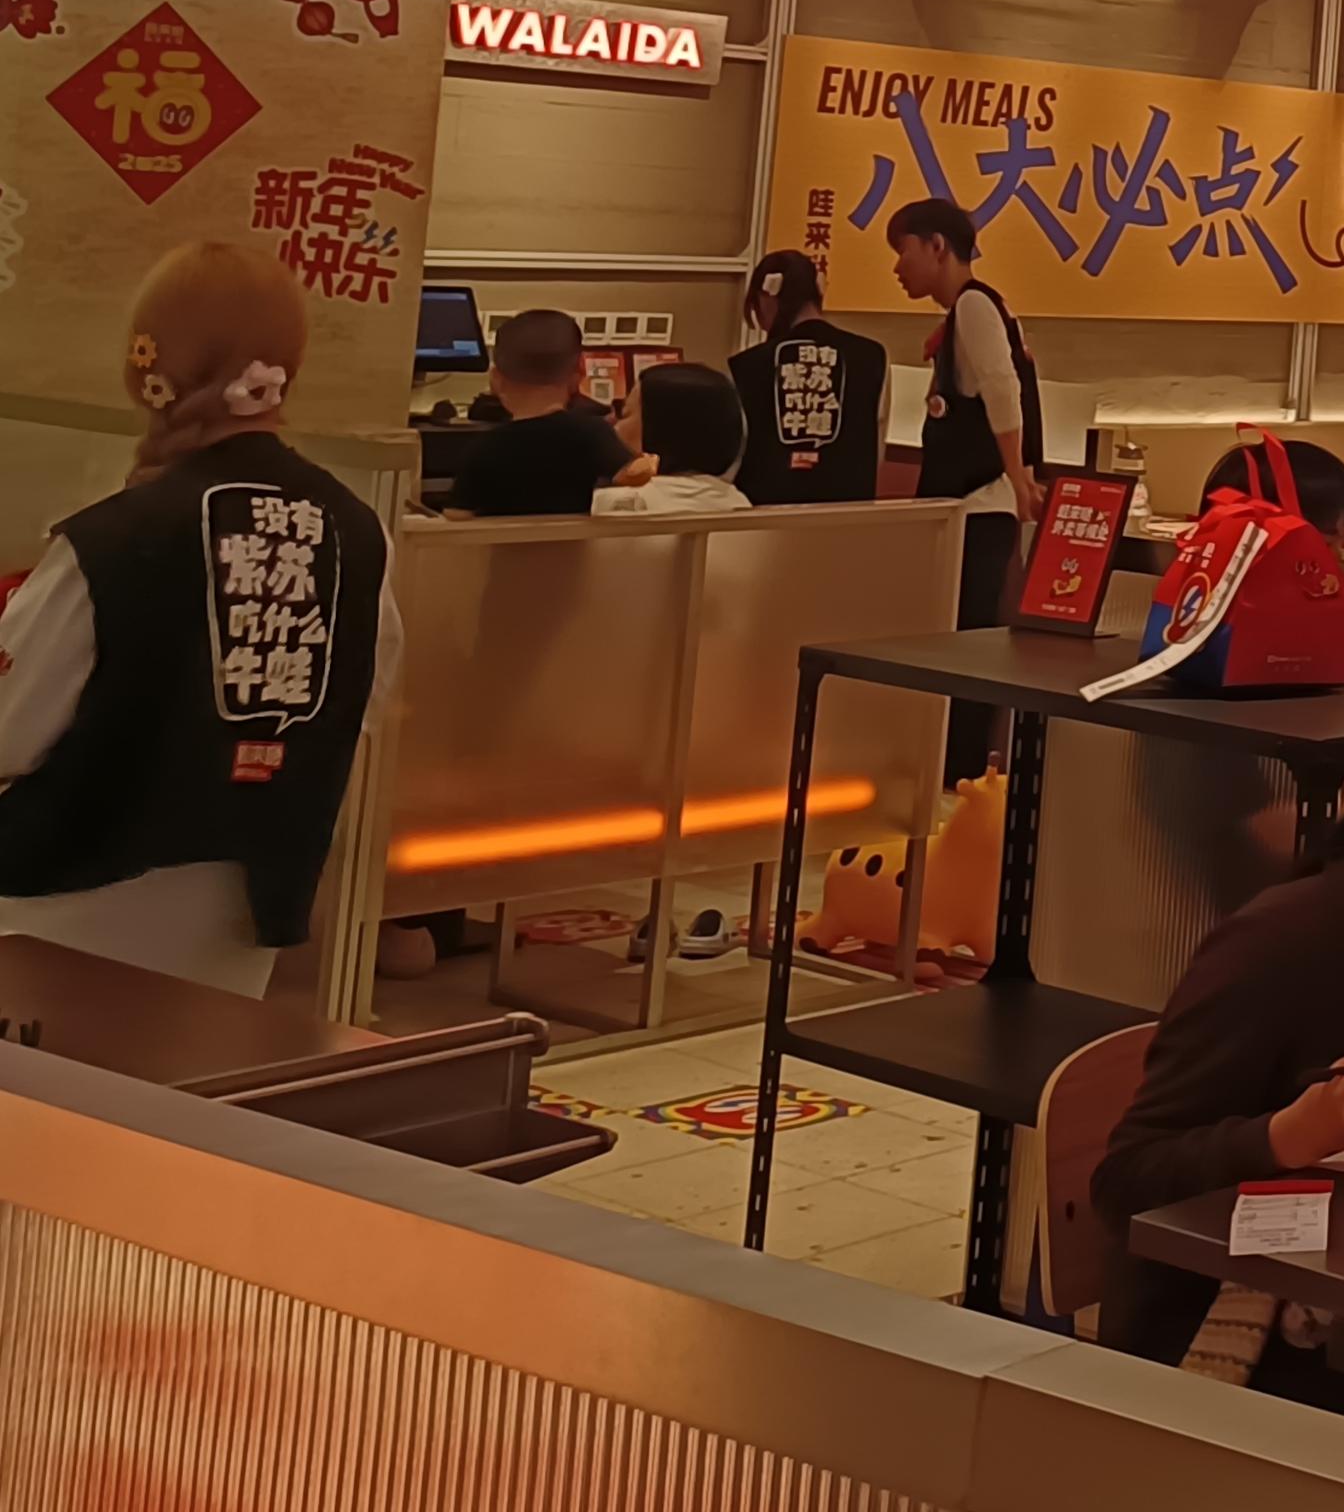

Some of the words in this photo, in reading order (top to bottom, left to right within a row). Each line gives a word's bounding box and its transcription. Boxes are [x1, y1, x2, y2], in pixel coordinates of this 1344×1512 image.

[453, 1, 701, 69] WALAIDA
[817, 66, 935, 119] ENJOY
[940, 78, 1057, 132] MEALS
[252, 168, 376, 236] 新年
[847, 90, 1298, 294] 八大必点
[279, 229, 397, 305] 快乐
[251, 496, 323, 545] 没有
[219, 534, 316, 601] 紫苏
[229, 600, 327, 644] 吃什么
[225, 646, 312, 705] 牛蛙
